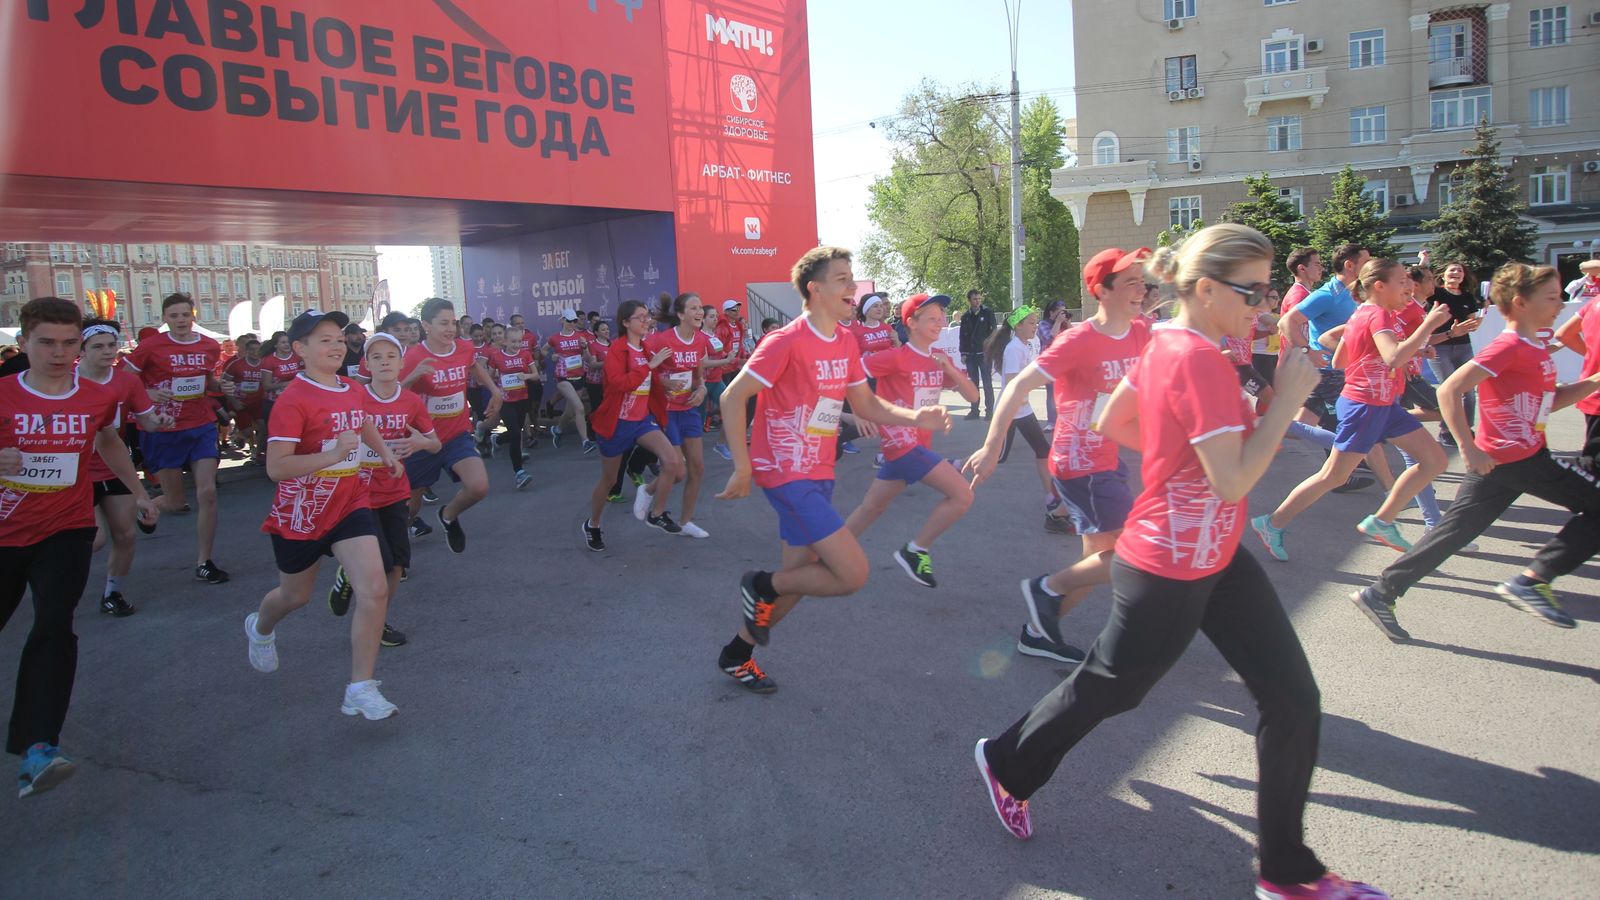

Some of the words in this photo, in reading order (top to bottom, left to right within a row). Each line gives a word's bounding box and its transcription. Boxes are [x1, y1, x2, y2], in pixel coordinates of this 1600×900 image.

[705, 14, 773, 56] МАТЧ!
[412, 35, 635, 114] БЕГОВОЕ
[100, 44, 461, 141] СОБЫТИЕ
[475, 101, 610, 161] ГОДА
[726, 115, 764, 128] СИБИРСКОЕ
[723, 125, 768, 140] ЗДОРОВЬЕ
[747, 168, 791, 185] ФИТНЕС
[731, 246, 777, 257] vk.com/zabegrf
[532, 283, 541, 298] С
[542, 274, 585, 297] ТОБОЙ
